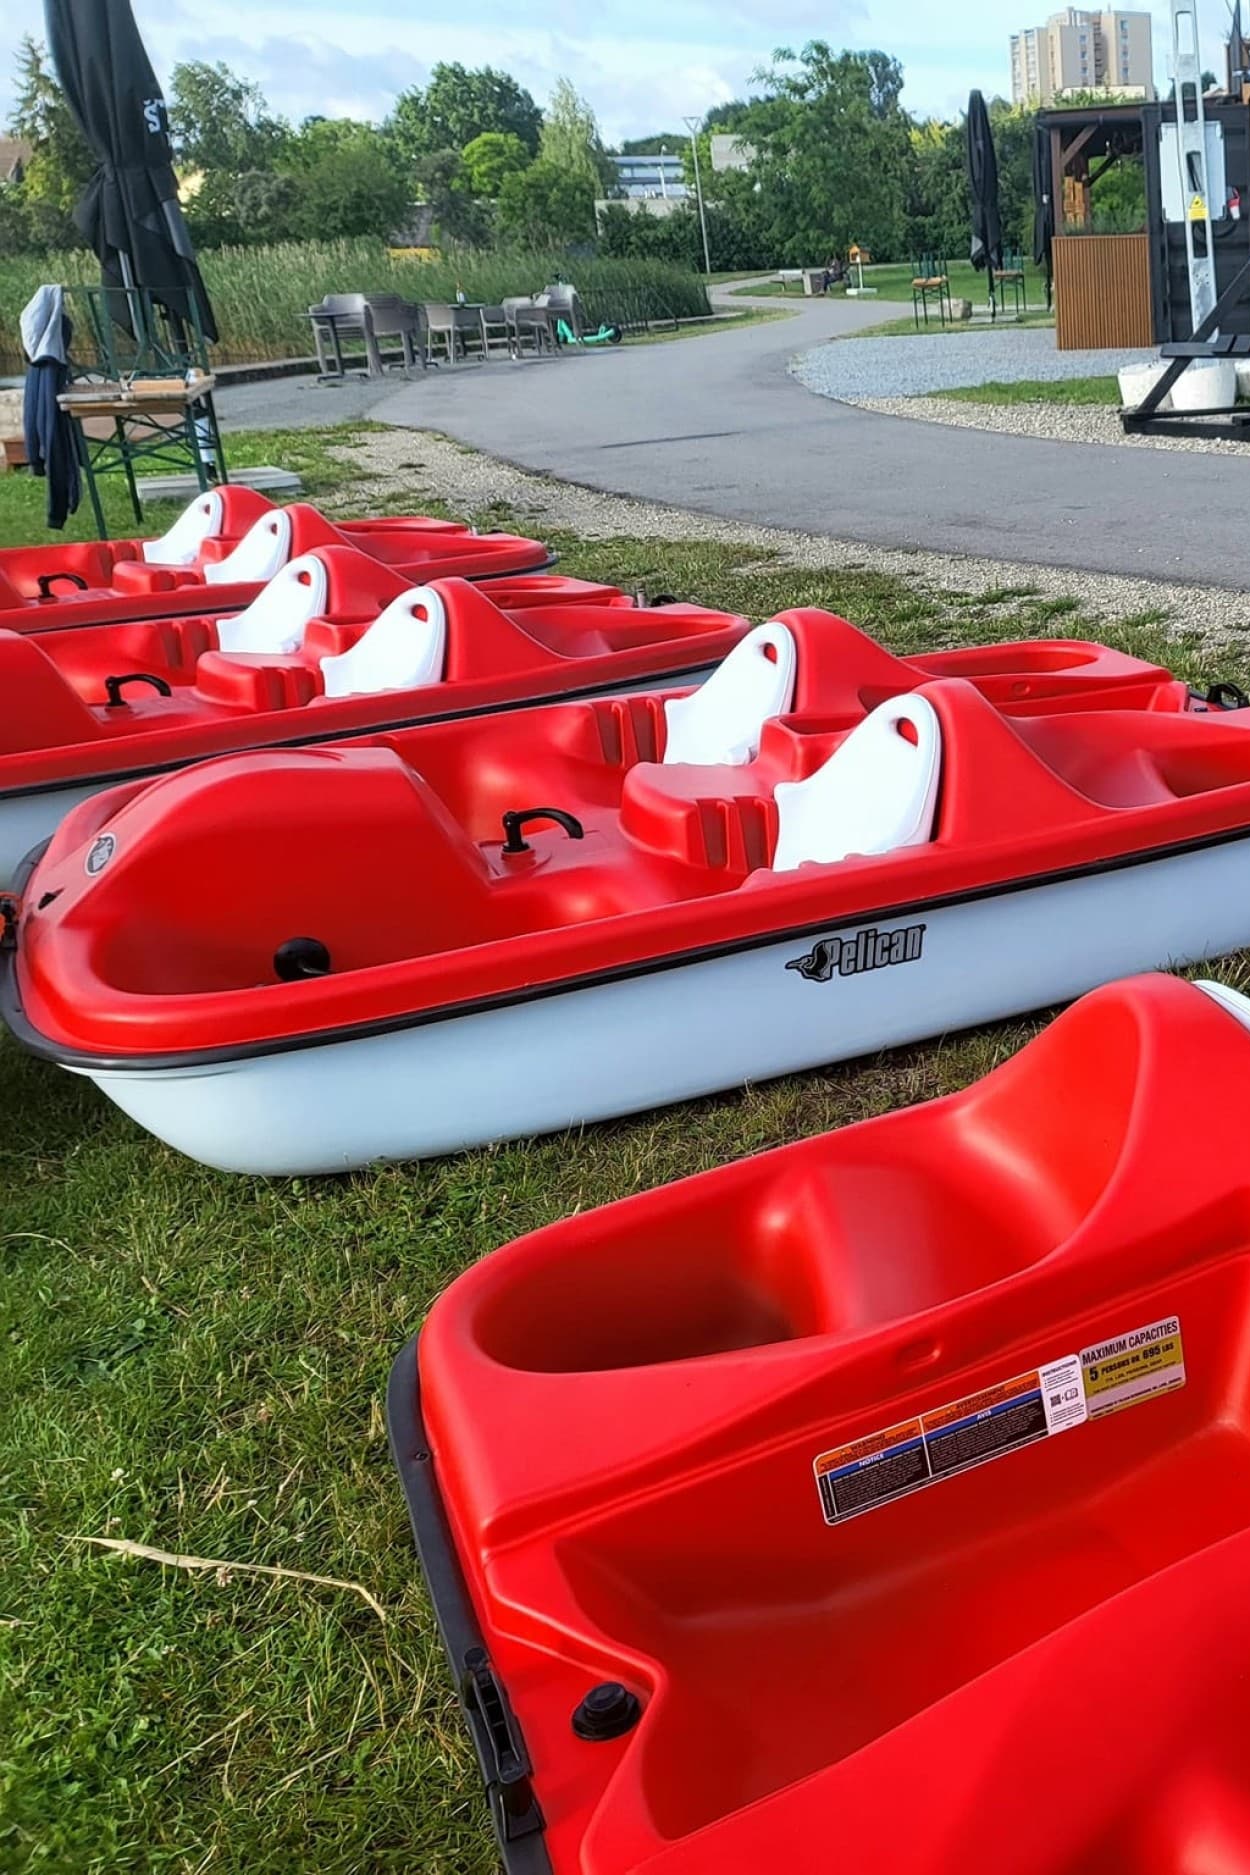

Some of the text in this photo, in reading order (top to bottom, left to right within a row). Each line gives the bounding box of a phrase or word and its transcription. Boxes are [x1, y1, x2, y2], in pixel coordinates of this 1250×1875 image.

[822, 926, 924, 981] Pelican
[1082, 1320, 1178, 1366] MAXIMUM CAPACITIES
[1089, 1366, 1099, 1382] 5
[1101, 1357, 1130, 1375] PERSONS
[1142, 1345, 1161, 1360] 695
[1162, 1342, 1174, 1352] LBS
[858, 1453, 885, 1467] NOTICE
